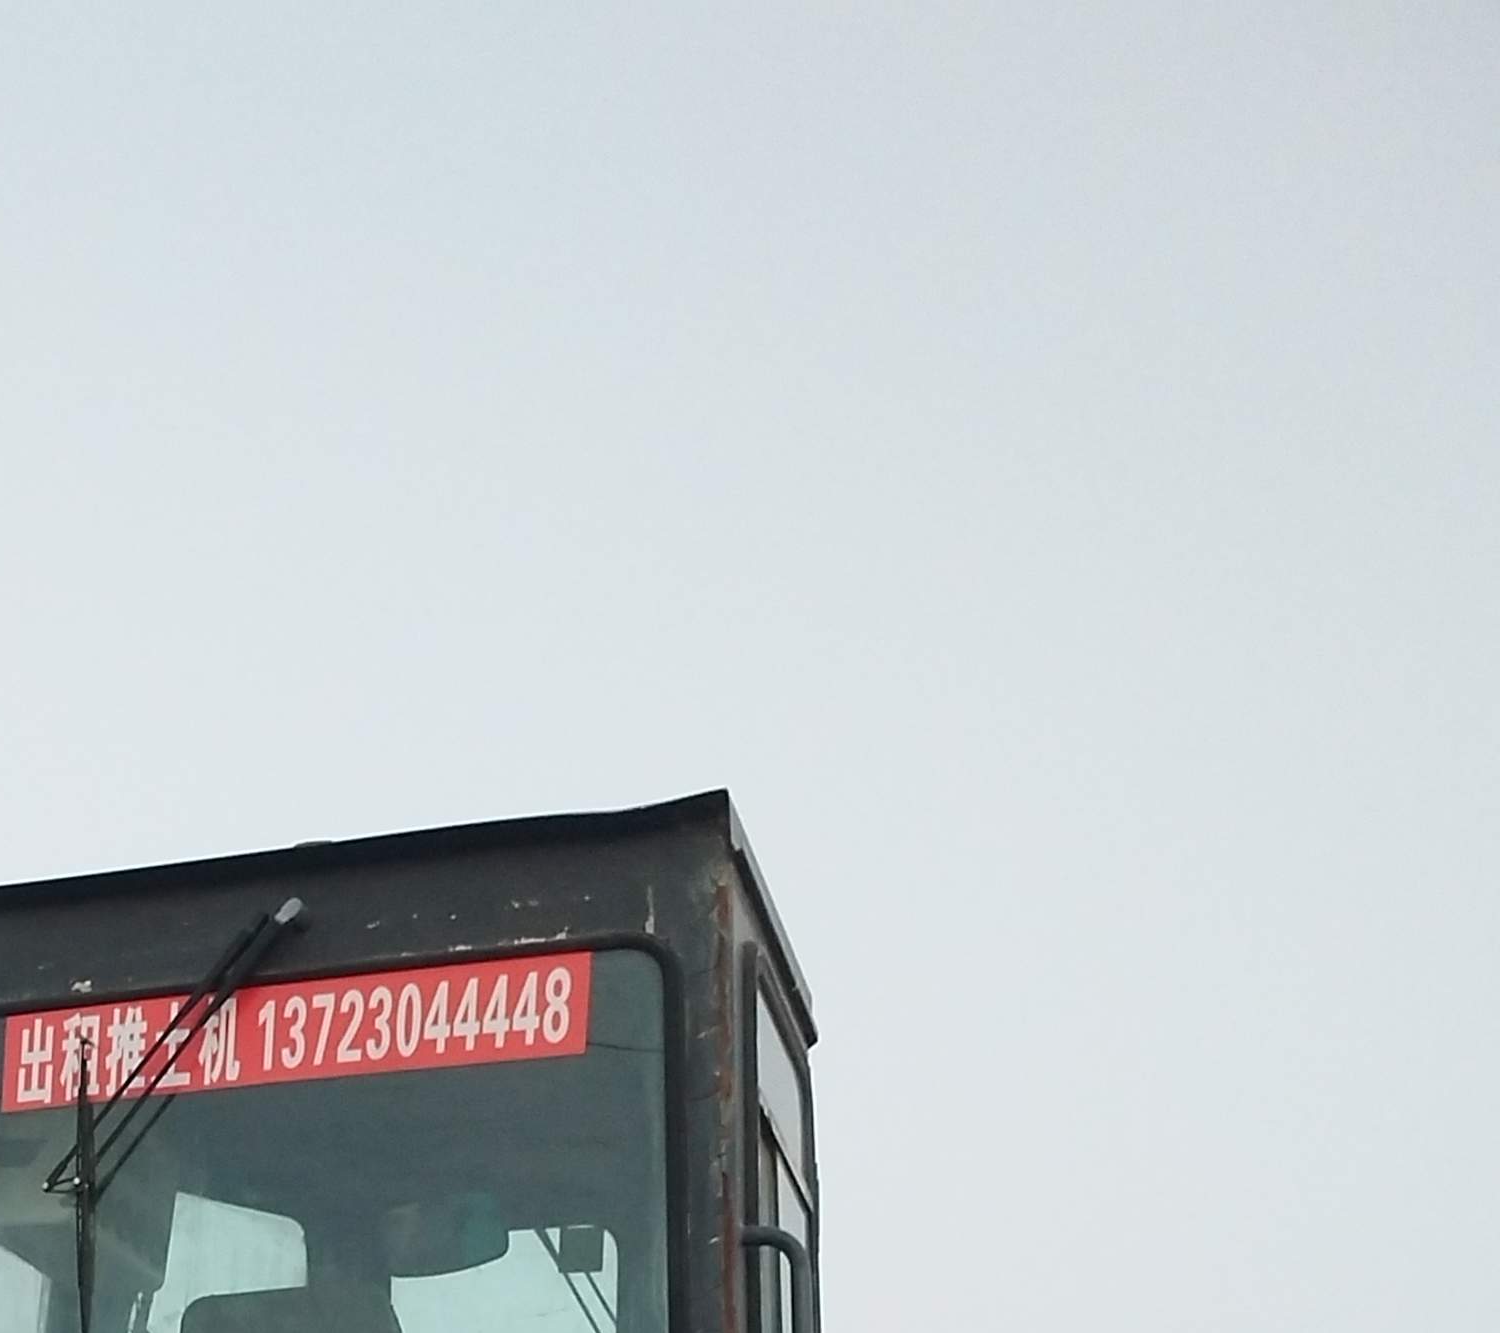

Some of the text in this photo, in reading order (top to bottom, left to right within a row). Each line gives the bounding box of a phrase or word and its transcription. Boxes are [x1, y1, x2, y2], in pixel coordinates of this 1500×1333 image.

[16, 967, 572, 1104] 出租推土机 13723044448
